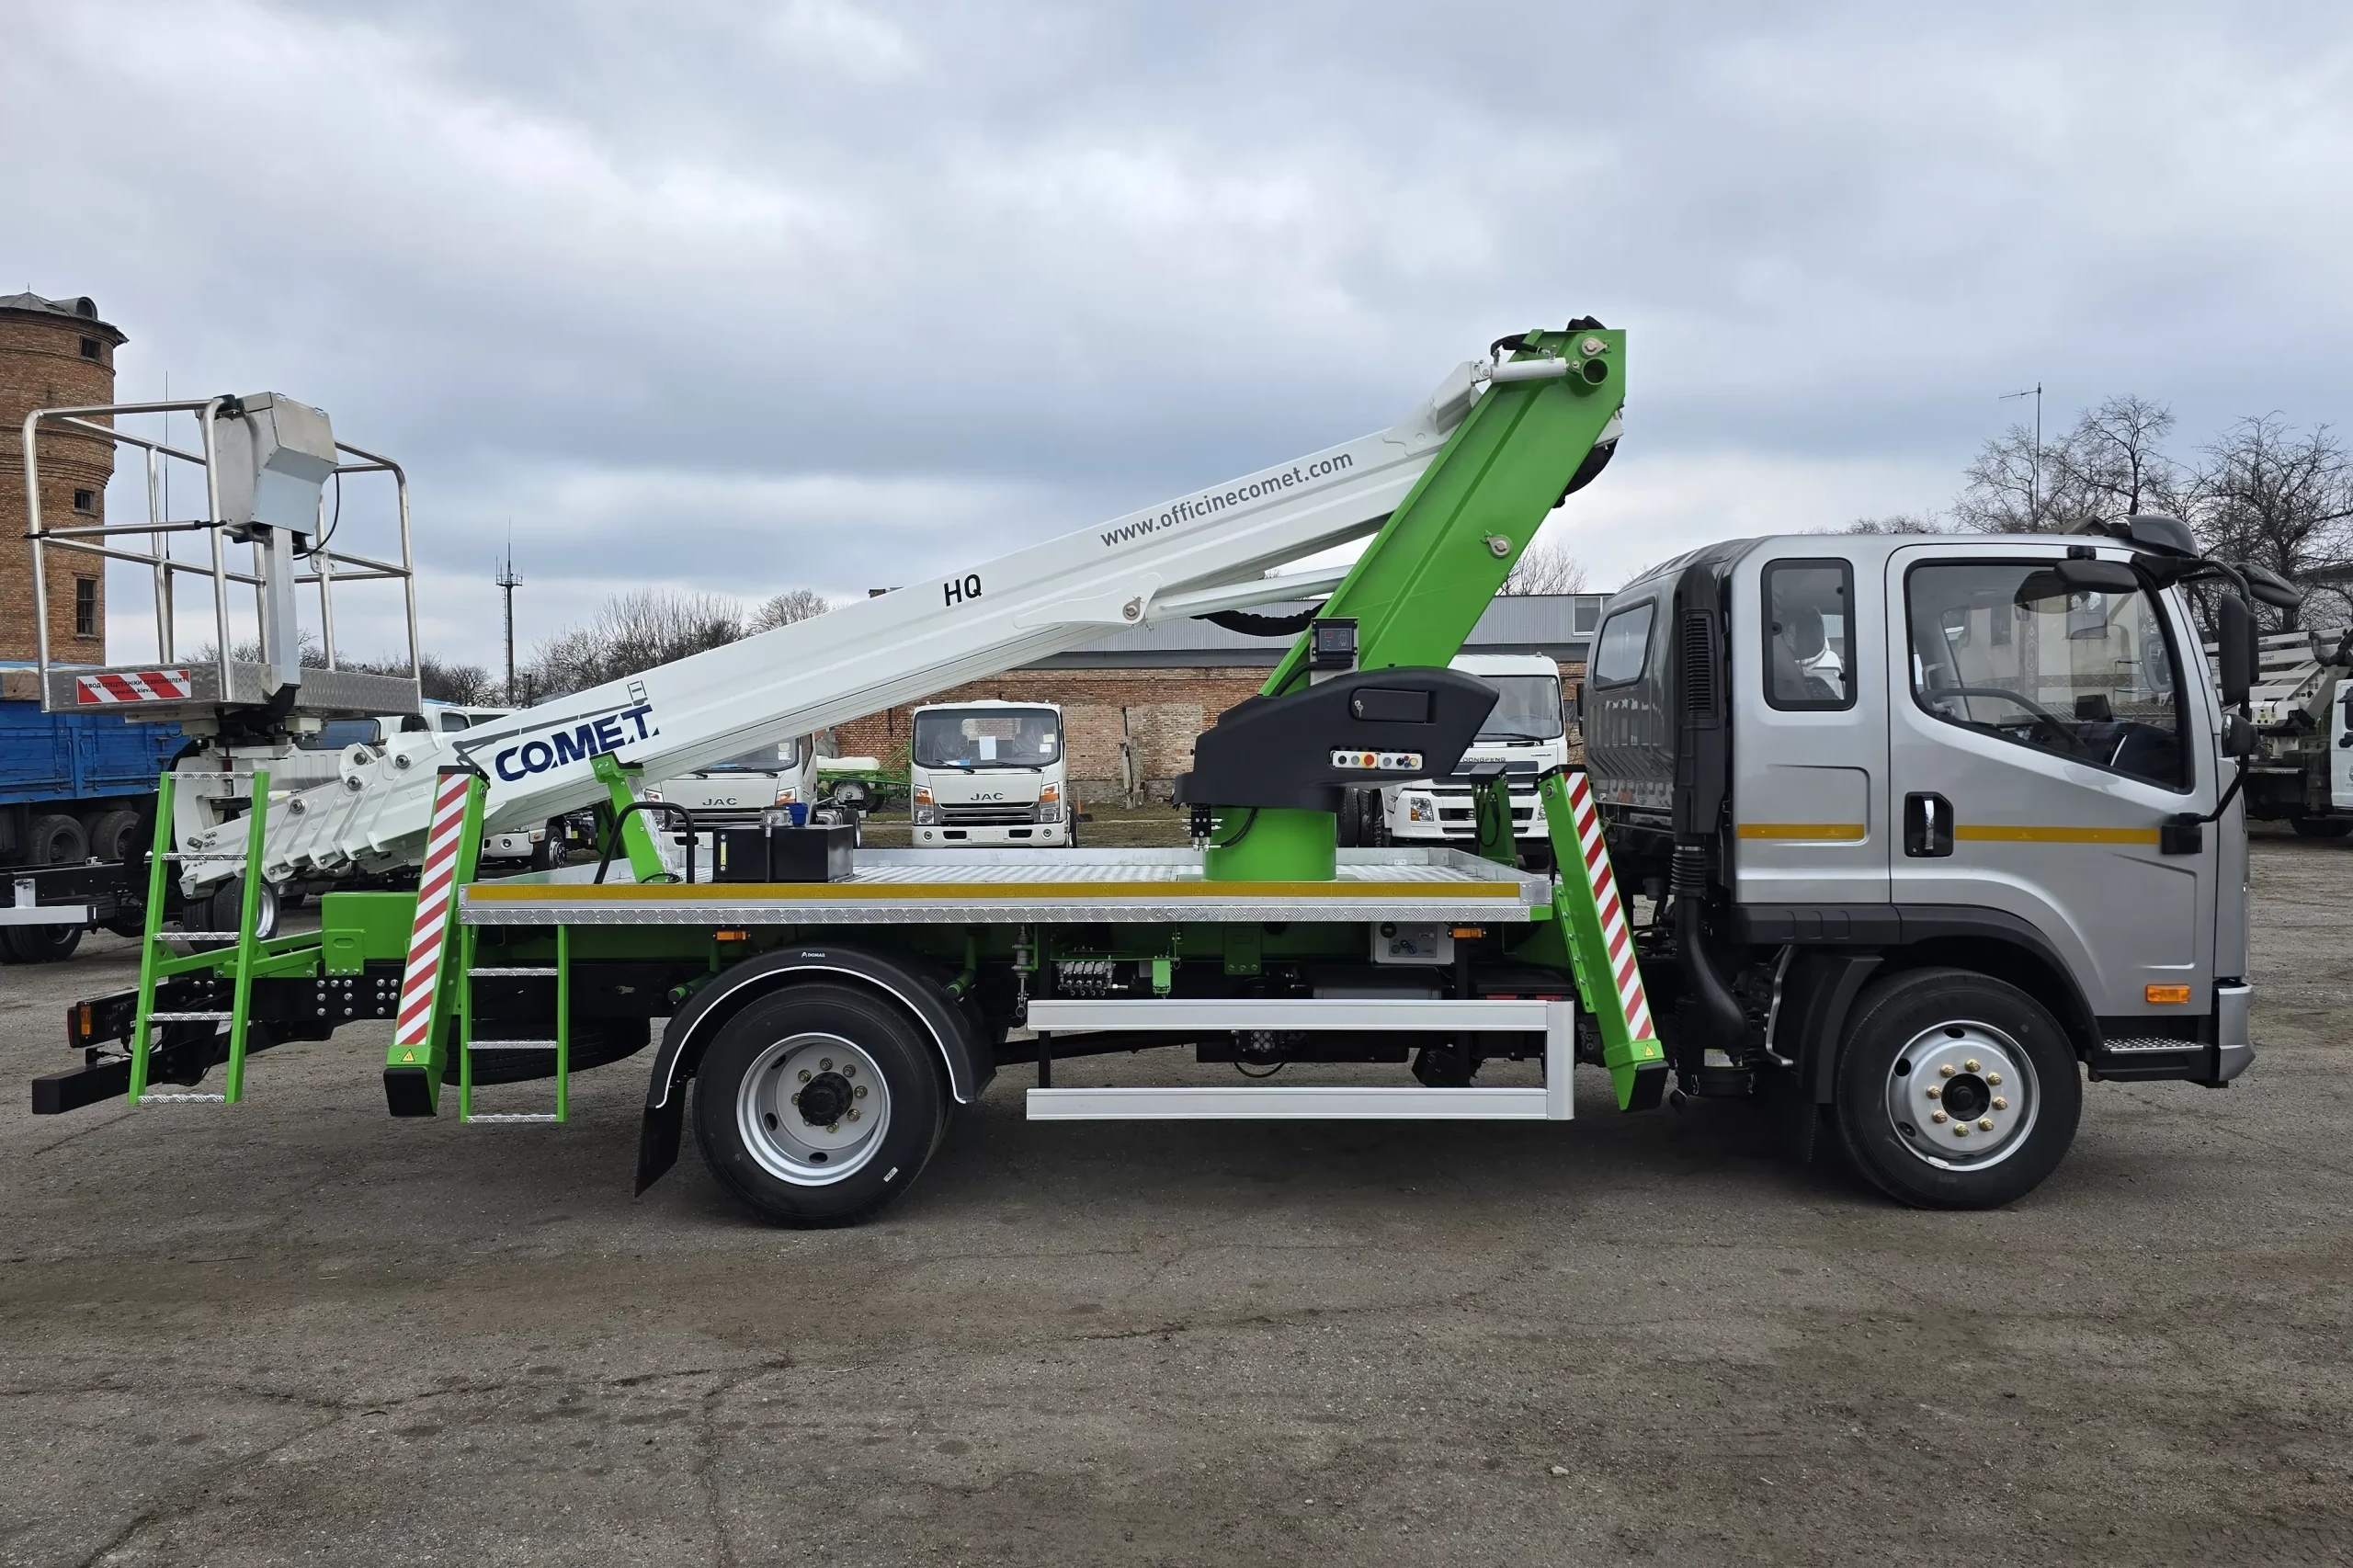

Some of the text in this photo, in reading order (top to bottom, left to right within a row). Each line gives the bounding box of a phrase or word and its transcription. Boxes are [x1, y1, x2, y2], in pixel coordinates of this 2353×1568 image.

[1100, 452, 1353, 547] www.officinecomet.com
[943, 574, 983, 608] HQ
[701, 797, 738, 807] JAC
[970, 791, 1005, 801] JAC
